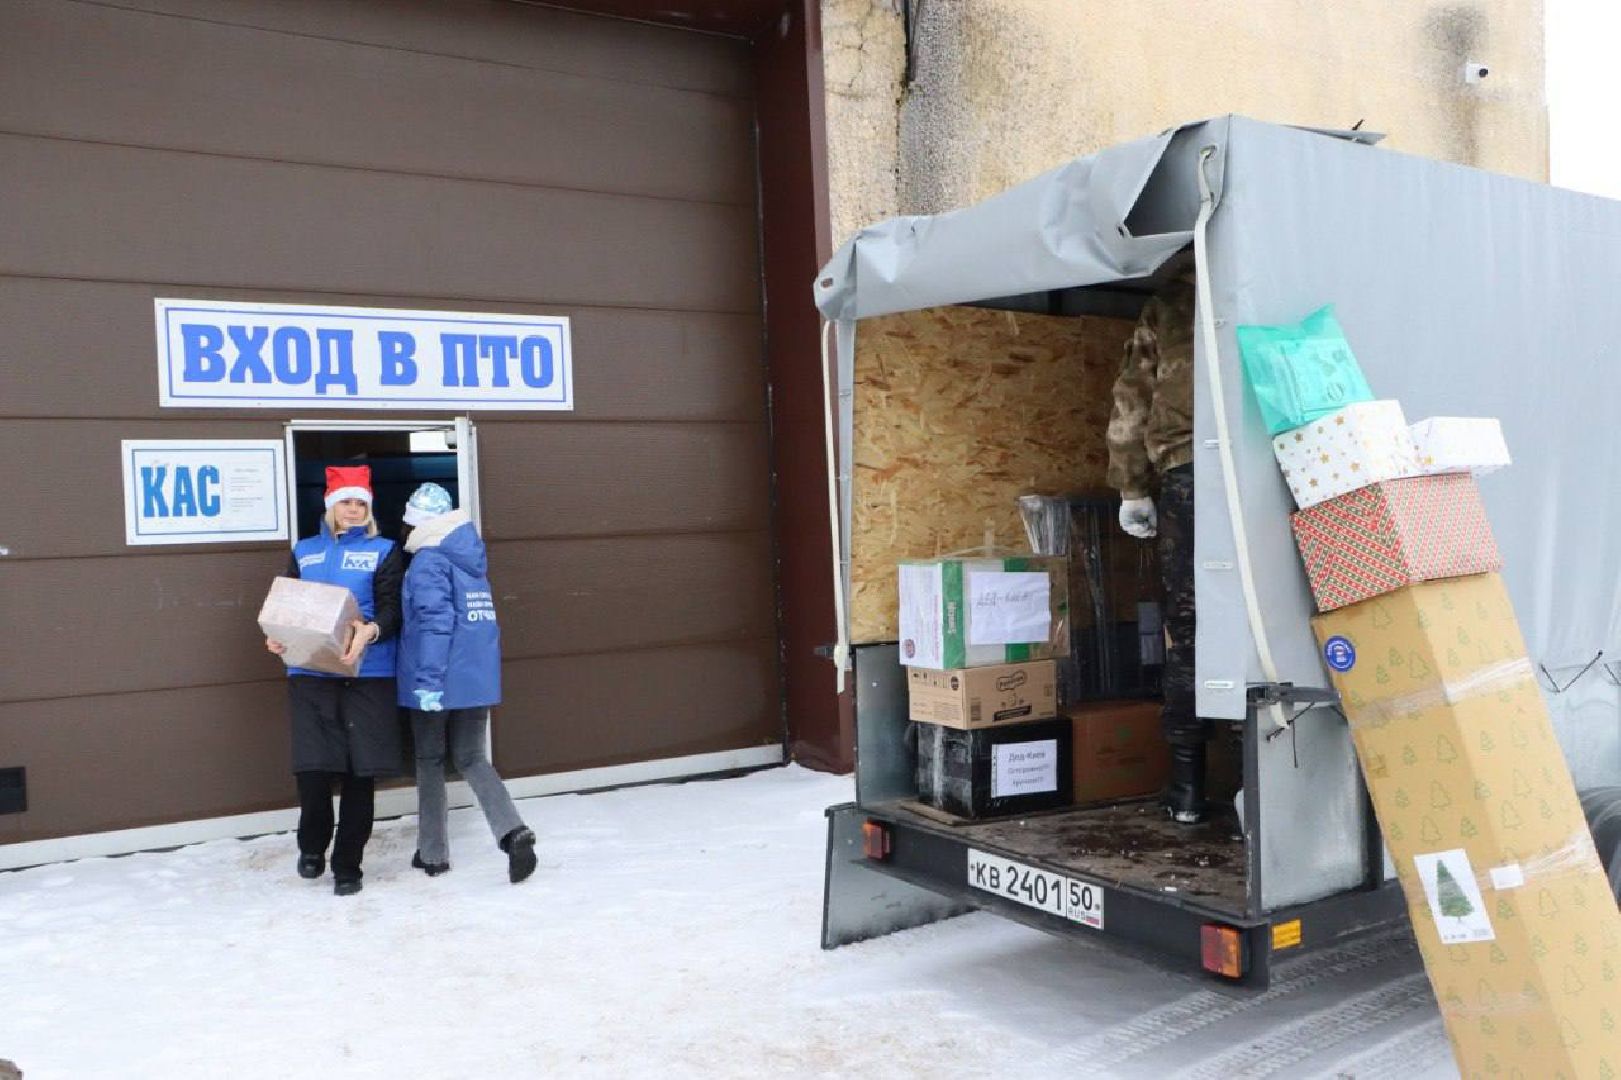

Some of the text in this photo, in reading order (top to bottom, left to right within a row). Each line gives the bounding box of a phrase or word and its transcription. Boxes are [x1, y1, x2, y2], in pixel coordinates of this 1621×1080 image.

[181, 324, 554, 395] ВХОД В ПТО
[140, 465, 220, 518] КАС
[1006, 866, 1061, 911] 2401
[1069, 881, 1093, 911] 50
